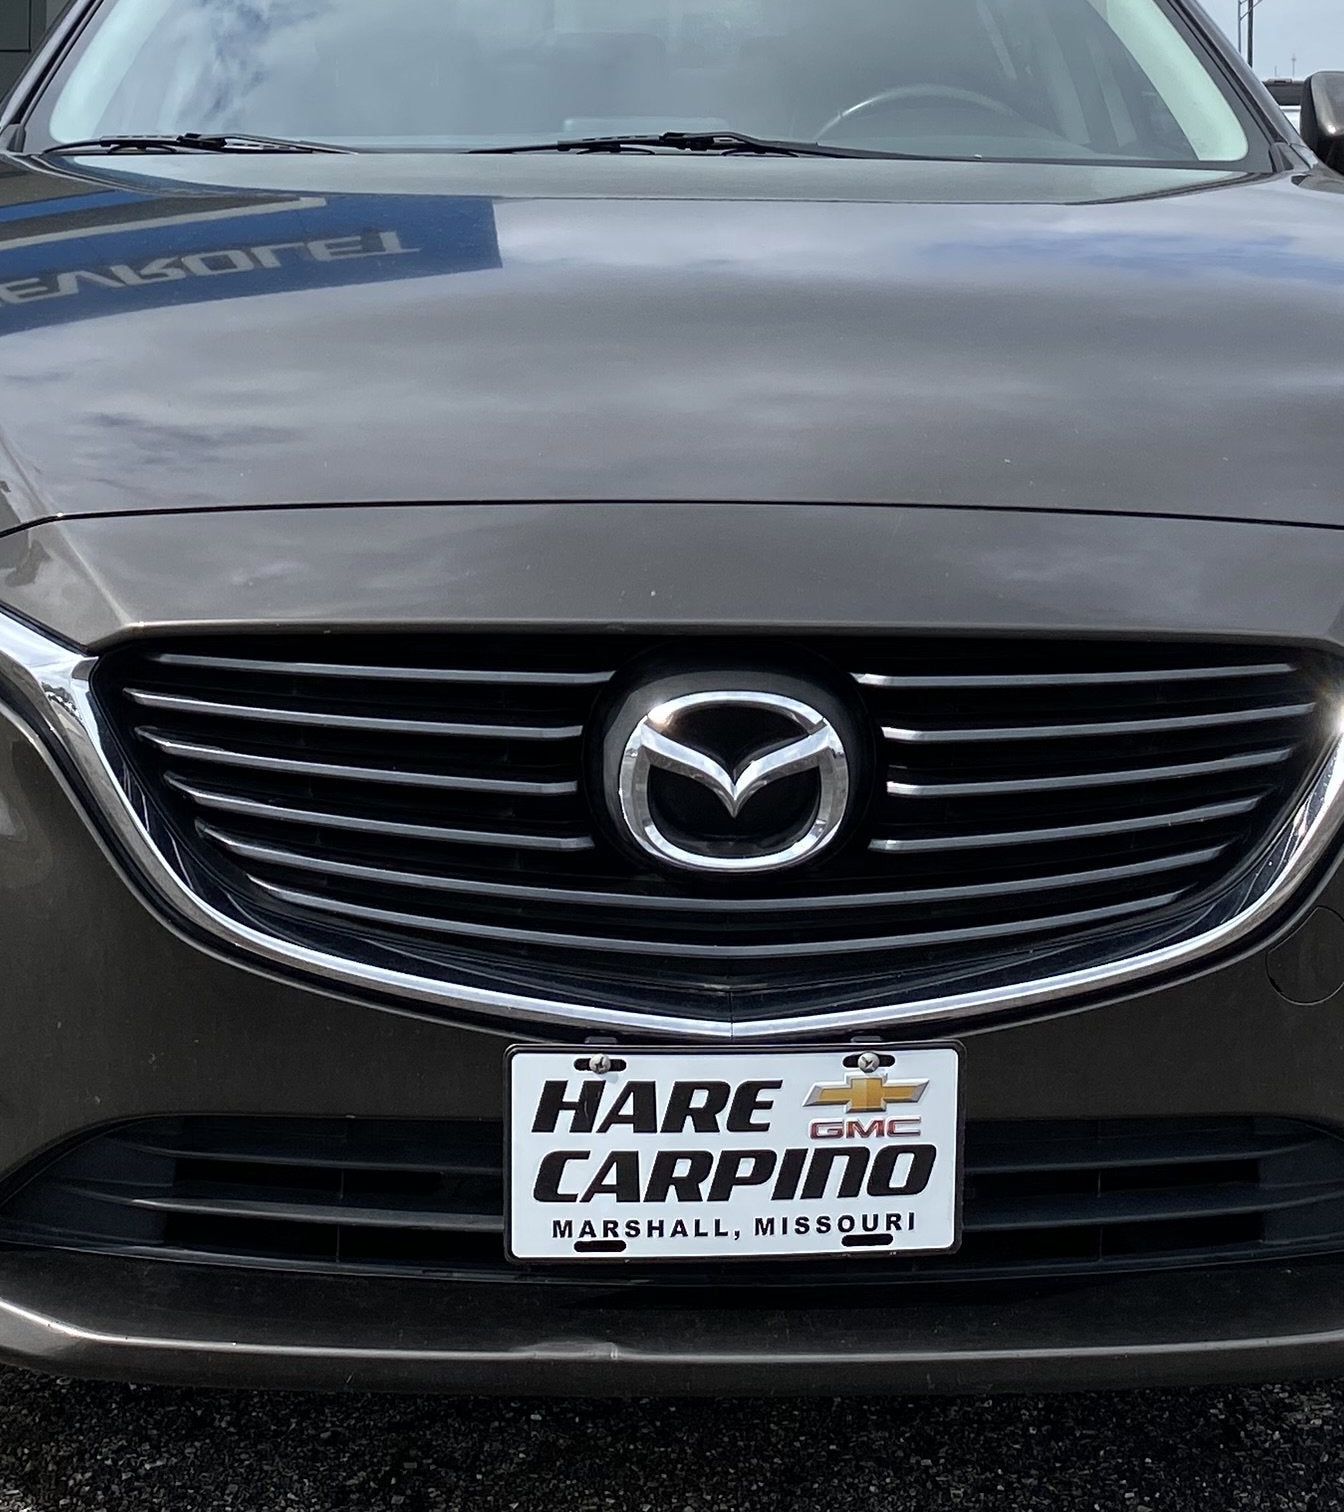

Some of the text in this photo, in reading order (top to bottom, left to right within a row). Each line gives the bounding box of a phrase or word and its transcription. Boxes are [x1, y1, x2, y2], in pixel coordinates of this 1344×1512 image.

[531, 1078, 784, 1134] HARE
[808, 1115, 922, 1141] GMC
[532, 1143, 938, 1203] CARPINO
[551, 1211, 916, 1241] MARSHALL, MISSOURI
